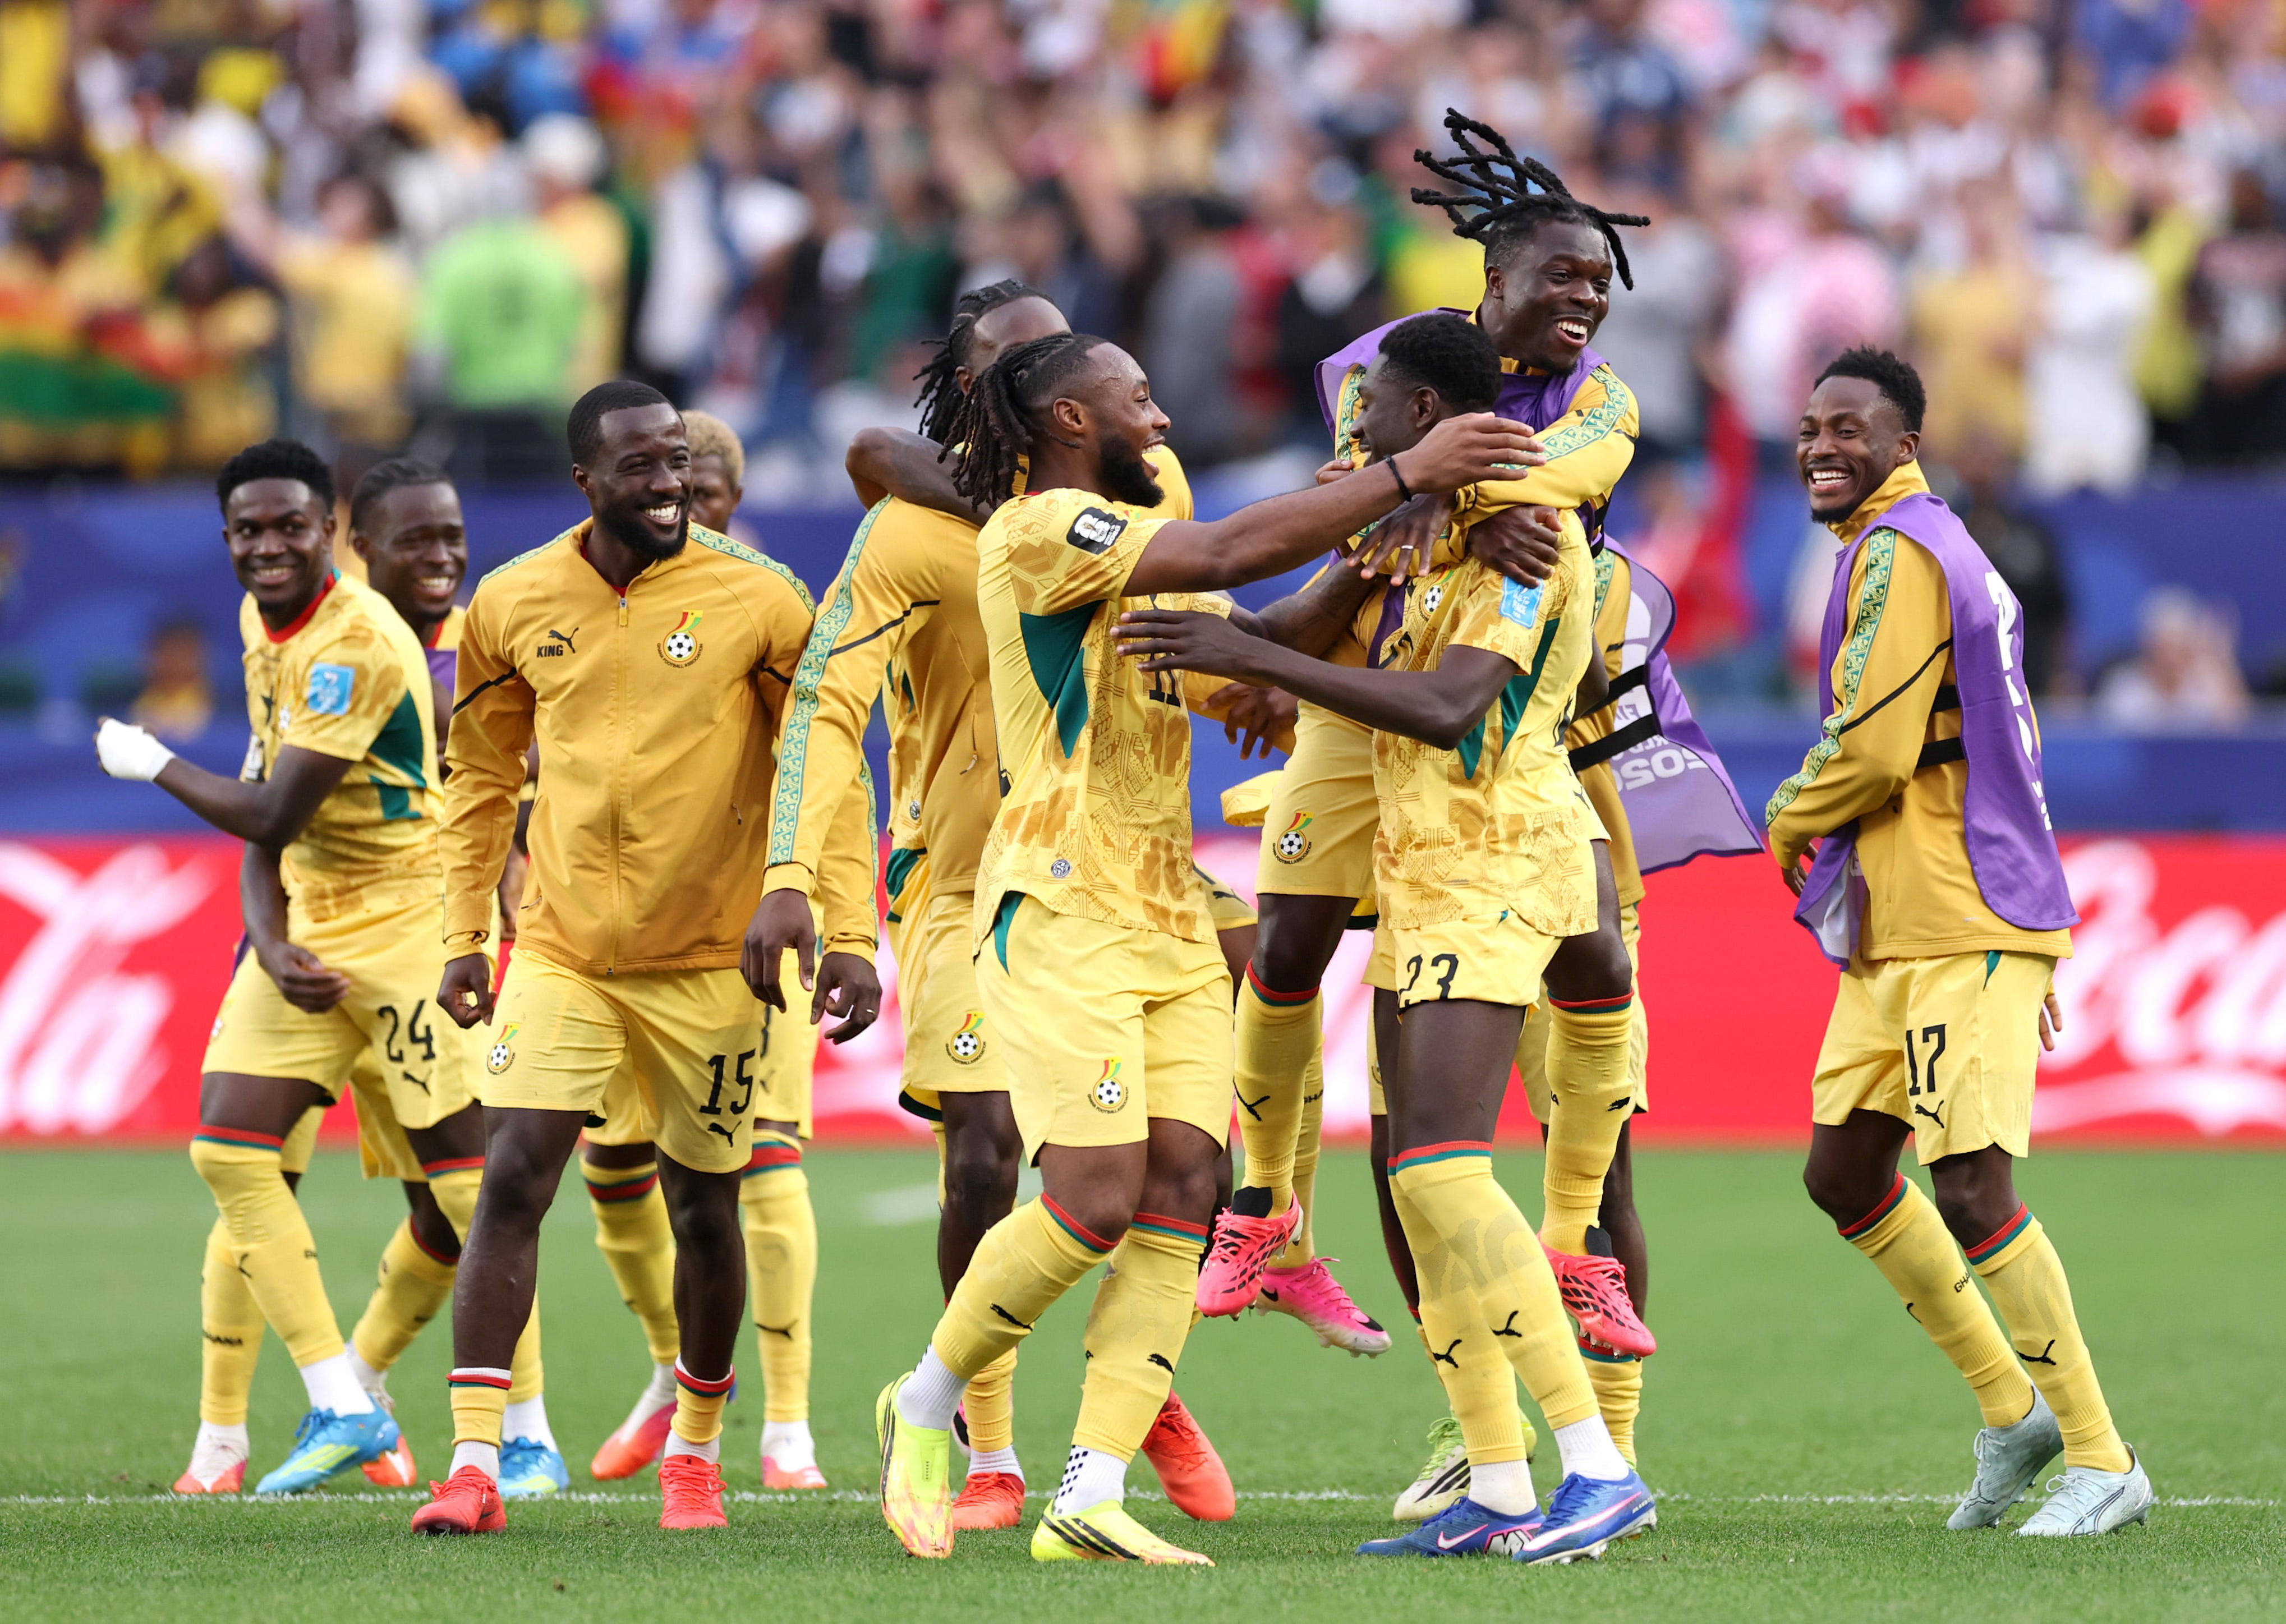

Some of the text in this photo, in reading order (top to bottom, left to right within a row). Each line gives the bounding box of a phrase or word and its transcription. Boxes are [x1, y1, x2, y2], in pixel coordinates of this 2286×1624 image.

[537, 645, 563, 658] KING
[378, 999, 436, 1064] 24
[1906, 1024, 1947, 1096] 17
[699, 1048, 756, 1115] 15
